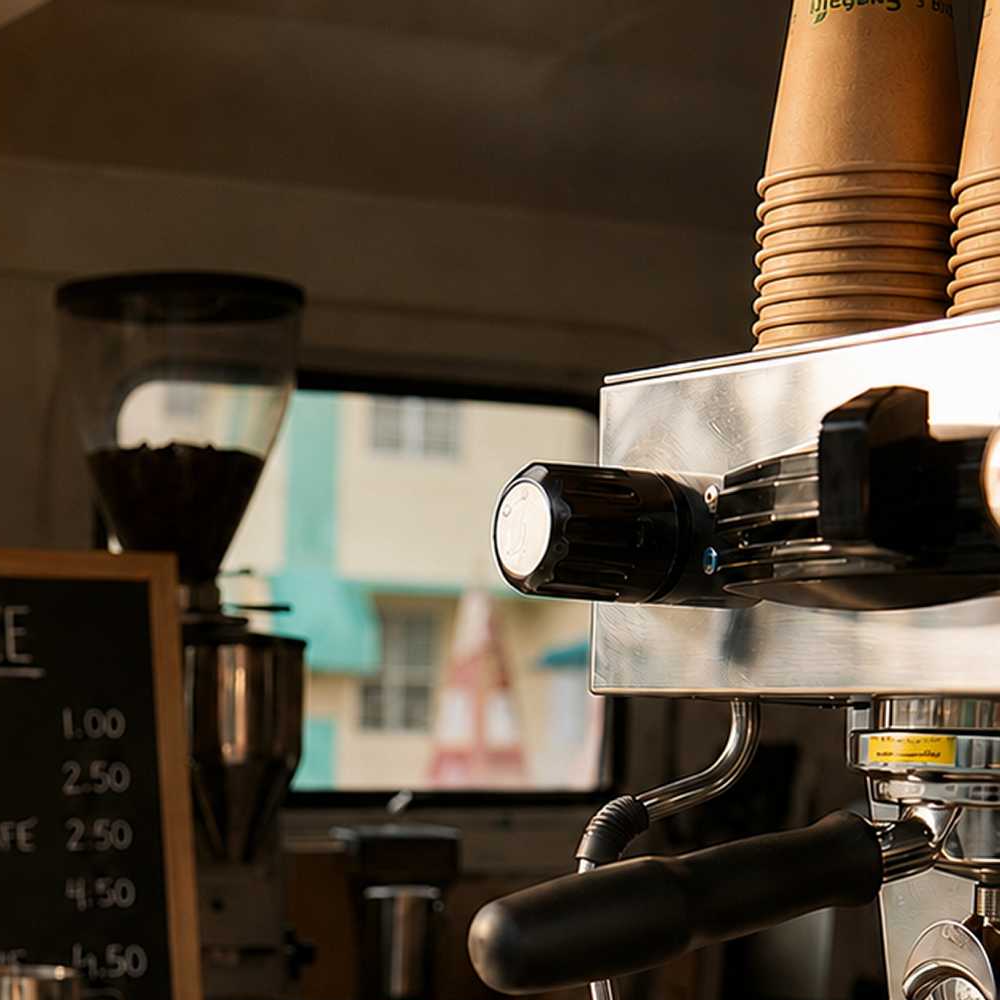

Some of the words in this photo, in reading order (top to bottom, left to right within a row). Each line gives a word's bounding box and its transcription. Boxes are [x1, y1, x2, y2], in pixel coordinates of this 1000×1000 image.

[62, 706, 127, 740] 1.00
[61, 760, 131, 796] 2.50
[64, 817, 134, 852] 2.50
[64, 877, 137, 912] 4.50
[72, 941, 149, 982] 4.50
